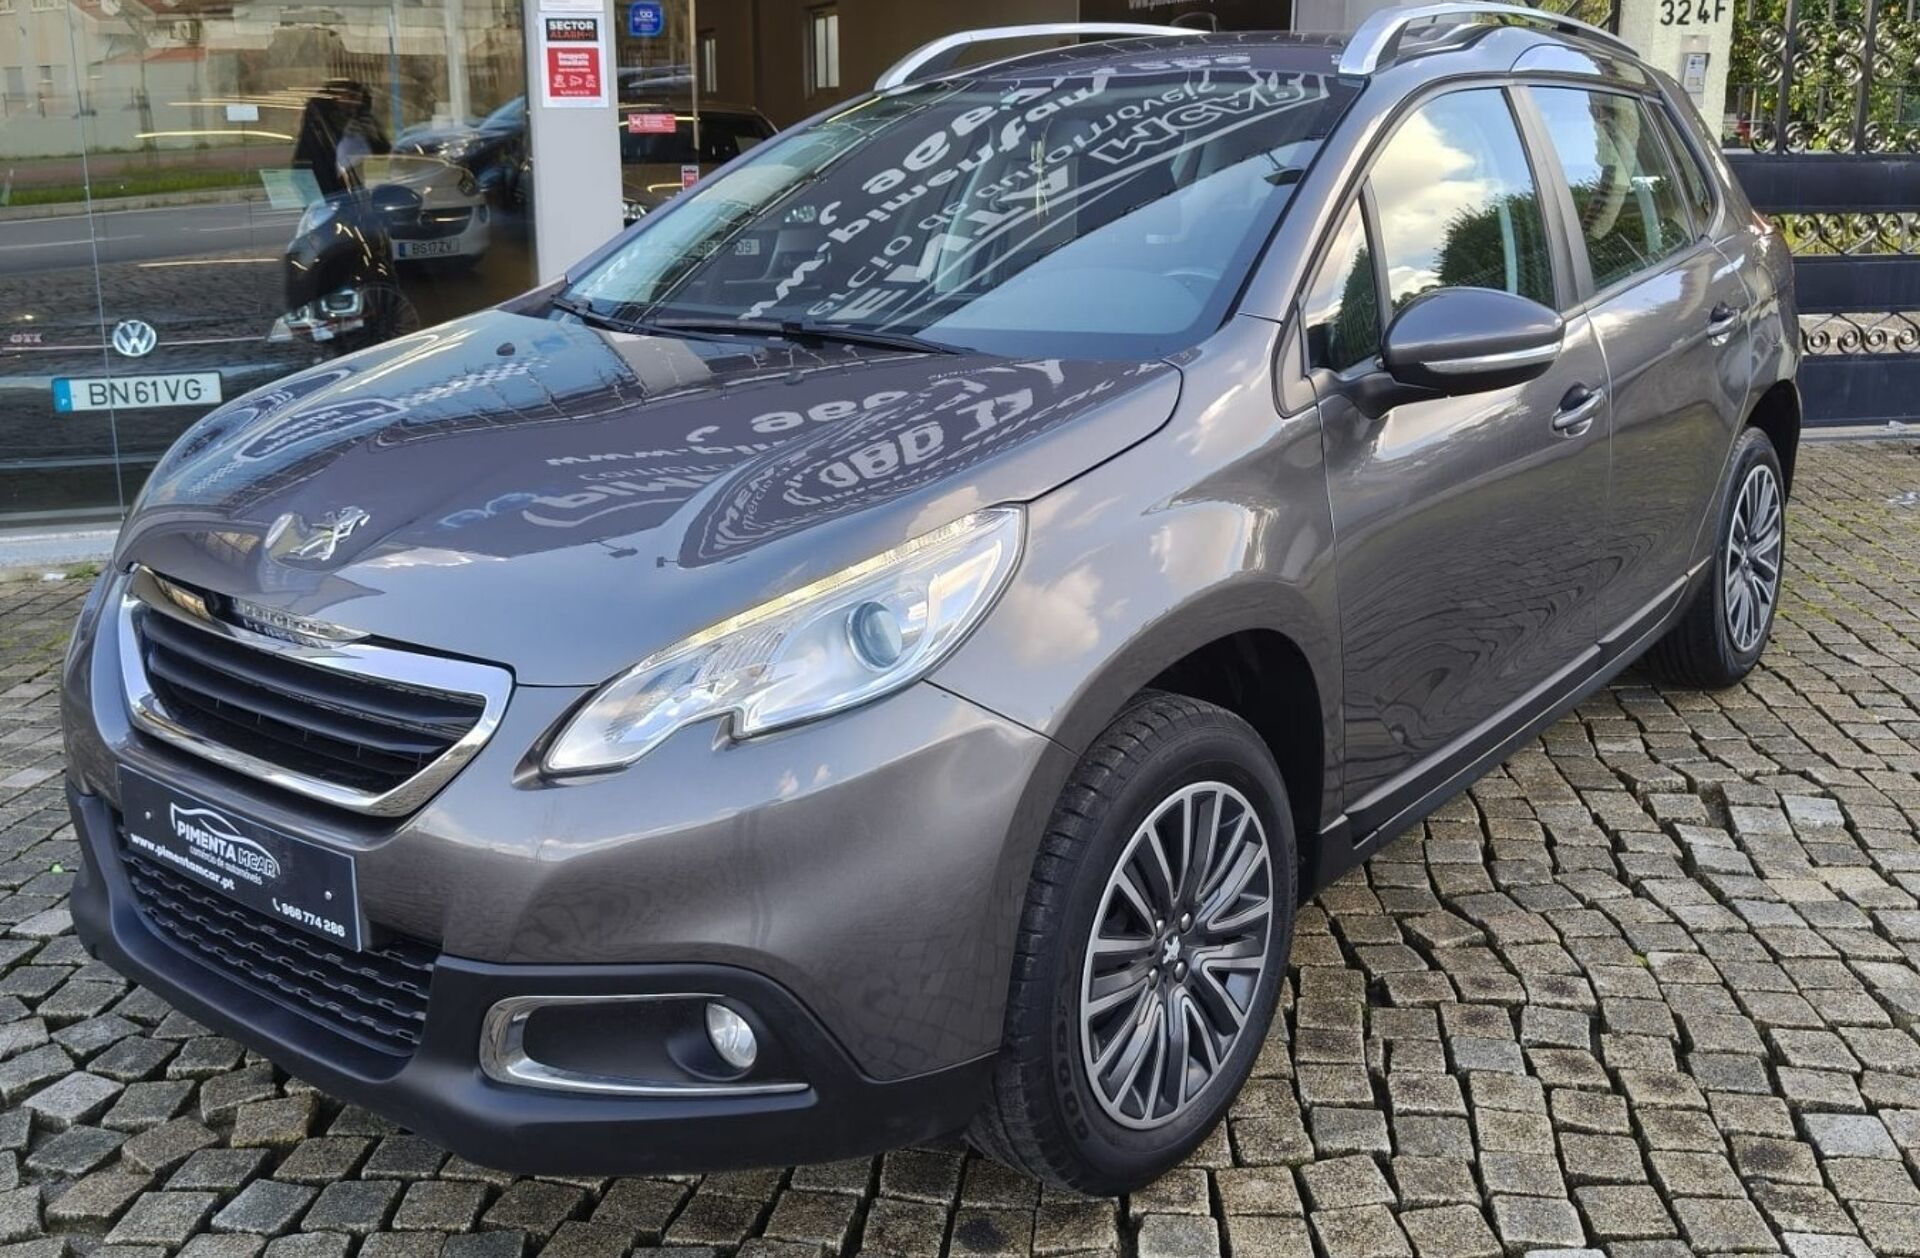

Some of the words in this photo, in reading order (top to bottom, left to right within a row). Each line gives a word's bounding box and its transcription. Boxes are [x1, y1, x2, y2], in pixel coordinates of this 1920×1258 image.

[548, 20, 595, 31] SECTOR
[1660, 0, 1726, 26] 324F
[9, 333, 43, 343] GTI
[88, 379, 203, 406] BN61VG
[176, 820, 237, 863] PIMENTA
[130, 833, 236, 891] www.pimentamcar.pt
[302, 910, 323, 929] 774
